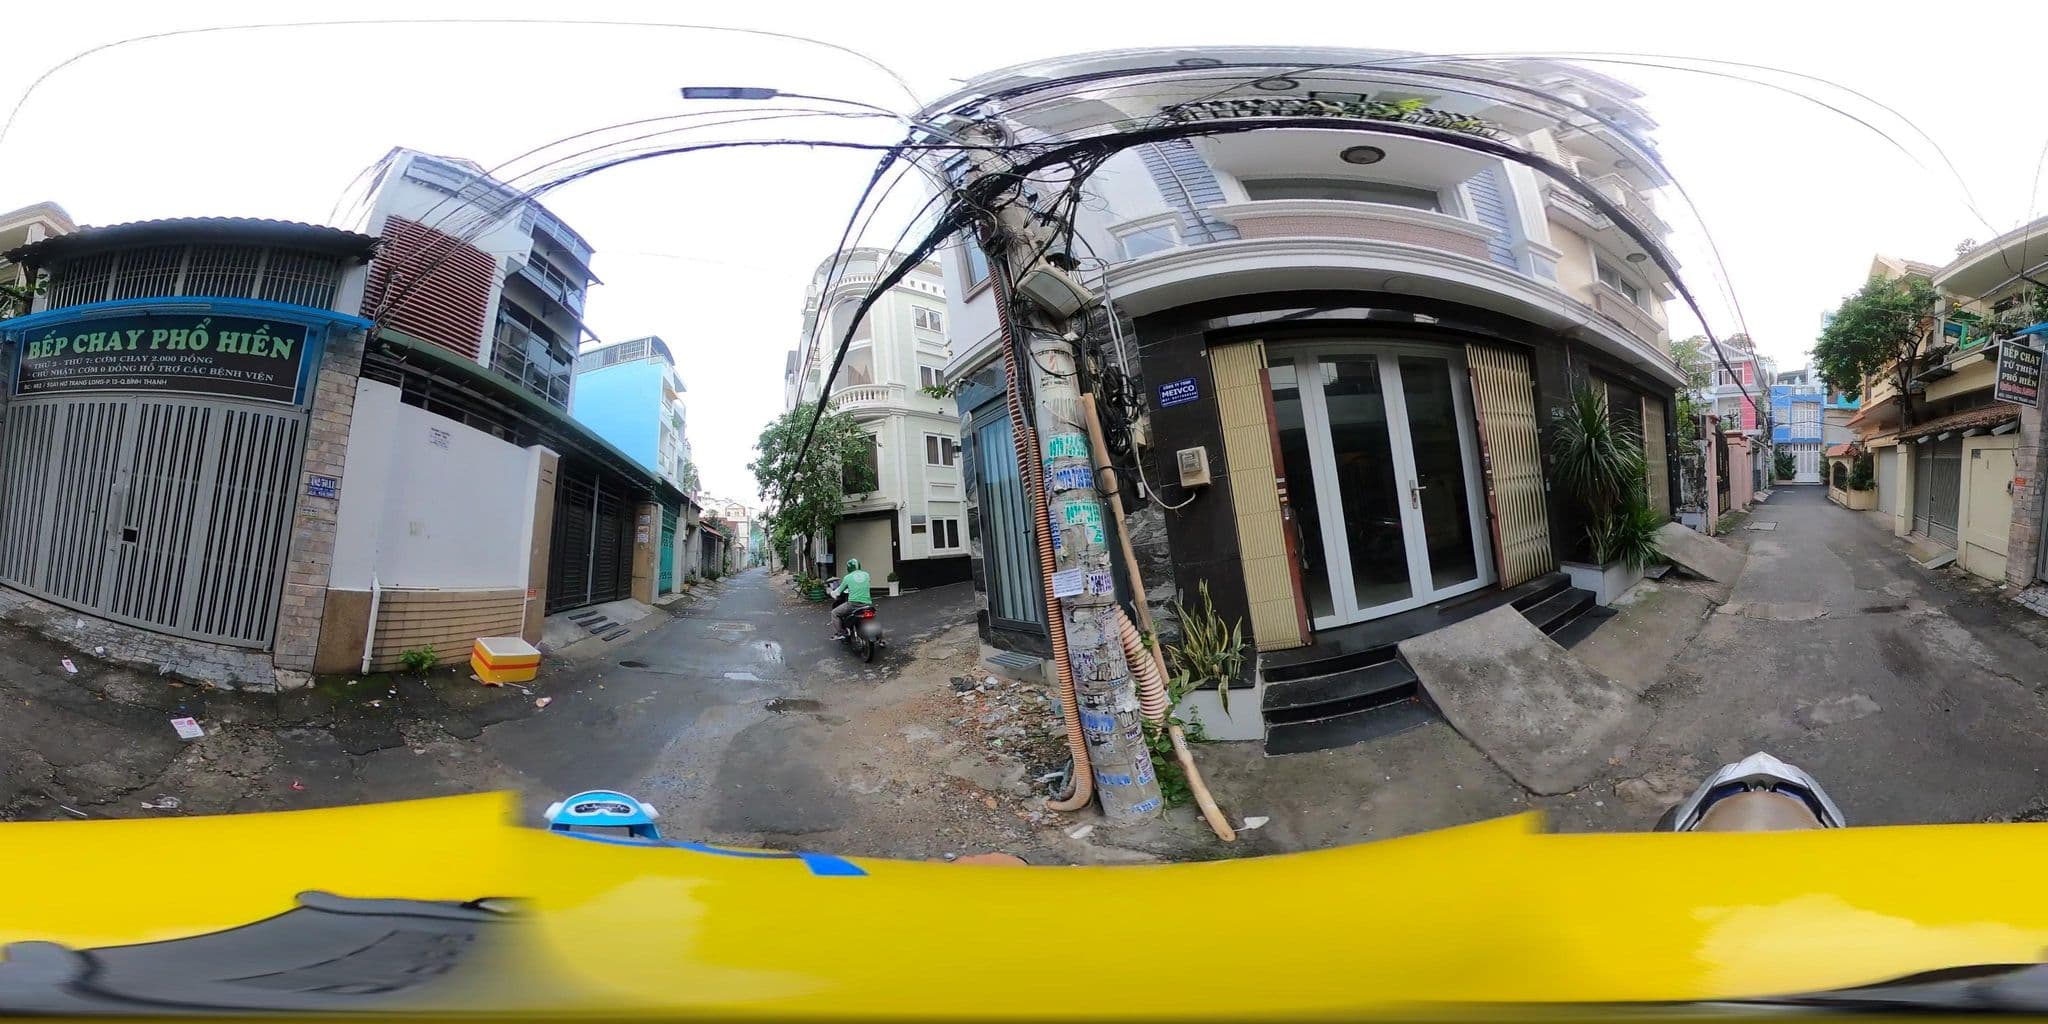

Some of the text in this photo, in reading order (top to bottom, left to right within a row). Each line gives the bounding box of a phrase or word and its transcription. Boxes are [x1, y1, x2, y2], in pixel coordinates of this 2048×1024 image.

[28, 317, 295, 360] BẾP CHAY PHỔ HIỀN
[119, 354, 151, 363] CHAY
[179, 353, 213, 364] ĐỒNG
[2003, 344, 2041, 366] BẾP CHAY
[158, 364, 181, 373] TRỢ
[183, 363, 207, 374] CÁC
[209, 367, 242, 378] BỆNH
[245, 371, 274, 382] VIỆN
[1162, 384, 1195, 398] MEIVCO
